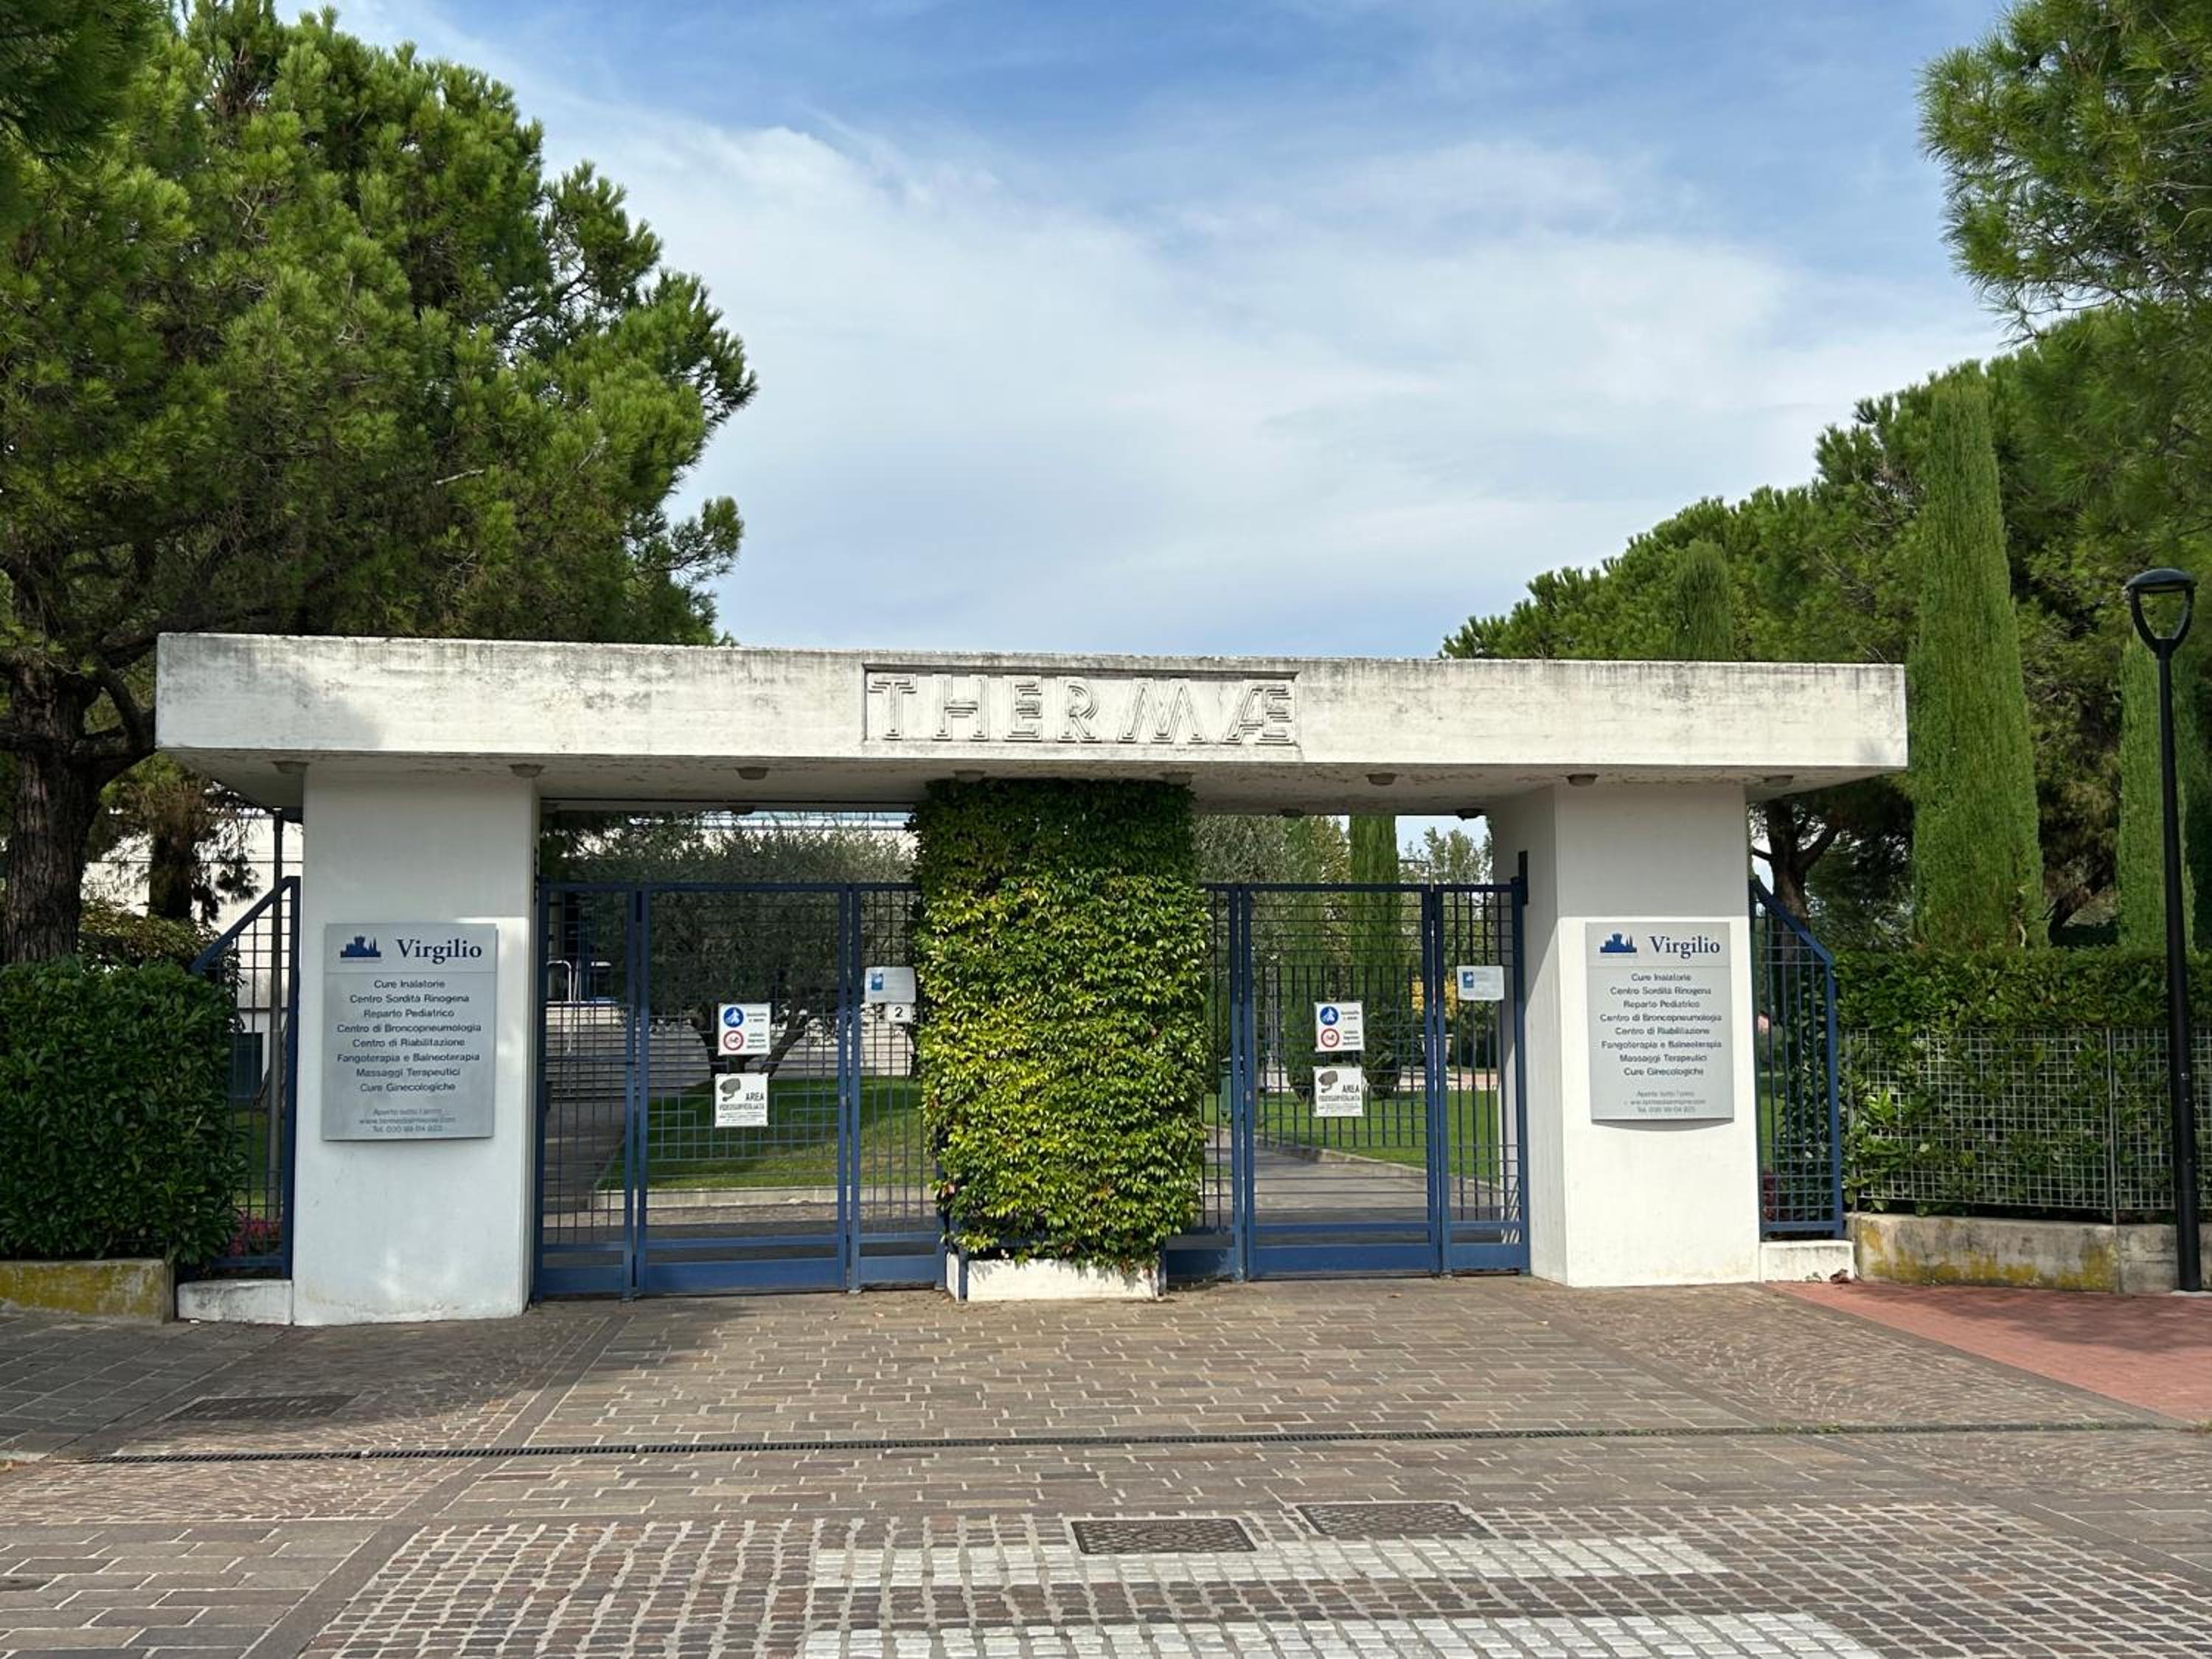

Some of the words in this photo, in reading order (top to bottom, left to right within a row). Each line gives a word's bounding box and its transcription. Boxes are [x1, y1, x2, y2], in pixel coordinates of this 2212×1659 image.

[867, 672, 1295, 745] THERMÆ
[396, 938, 482, 964] Virgilio
[1649, 936, 1720, 959] Virgilio
[1631, 973, 1652, 981] Cure
[1655, 973, 1691, 981] Inalatorie
[374, 980, 397, 988] Cure
[400, 979, 445, 988] Inalatorie
[1610, 987, 1640, 995] Centro
[349, 995, 382, 1004] Centro
[386, 994, 421, 1003] Sordità
[424, 994, 469, 1004] Rinogena
[1623, 1001, 1657, 1009] Reparto
[363, 1009, 403, 1019] Reparto
[406, 1009, 454, 1018] Pediatrico
[895, 1006, 903, 1018] 2
[1600, 1014, 1630, 1022] Centro
[1632, 1013, 1640, 1021] di
[1643, 1014, 1722, 1023] Broncopneumologia
[336, 1024, 369, 1033] Centro
[372, 1023, 381, 1032] di
[385, 1023, 481, 1034] Broncopneumologia
[1615, 1027, 1645, 1035] Centro
[1647, 1026, 1655, 1034] di
[352, 1038, 386, 1047] Centro
[389, 1038, 397, 1047] di
[401, 1038, 465, 1047] Riabilitazione
[1601, 1040, 1658, 1050] Fangoterapia
[1669, 1040, 1722, 1049] Balneoterapia
[337, 1053, 400, 1064] Fangoterapia
[413, 1053, 479, 1063] Balneoterapia
[1620, 1054, 1660, 1063] Massaggi
[1664, 1054, 1708, 1063] Terapeutici
[355, 1068, 403, 1078] Massaggi
[407, 1068, 460, 1078] Terapeutici
[1624, 1067, 1644, 1076] Cure
[1647, 1067, 1704, 1077] Ginecologiche
[360, 1082, 383, 1093] Cure
[386, 1082, 456, 1093] Ginecologiche
[1342, 1085, 1360, 1093] AREA
